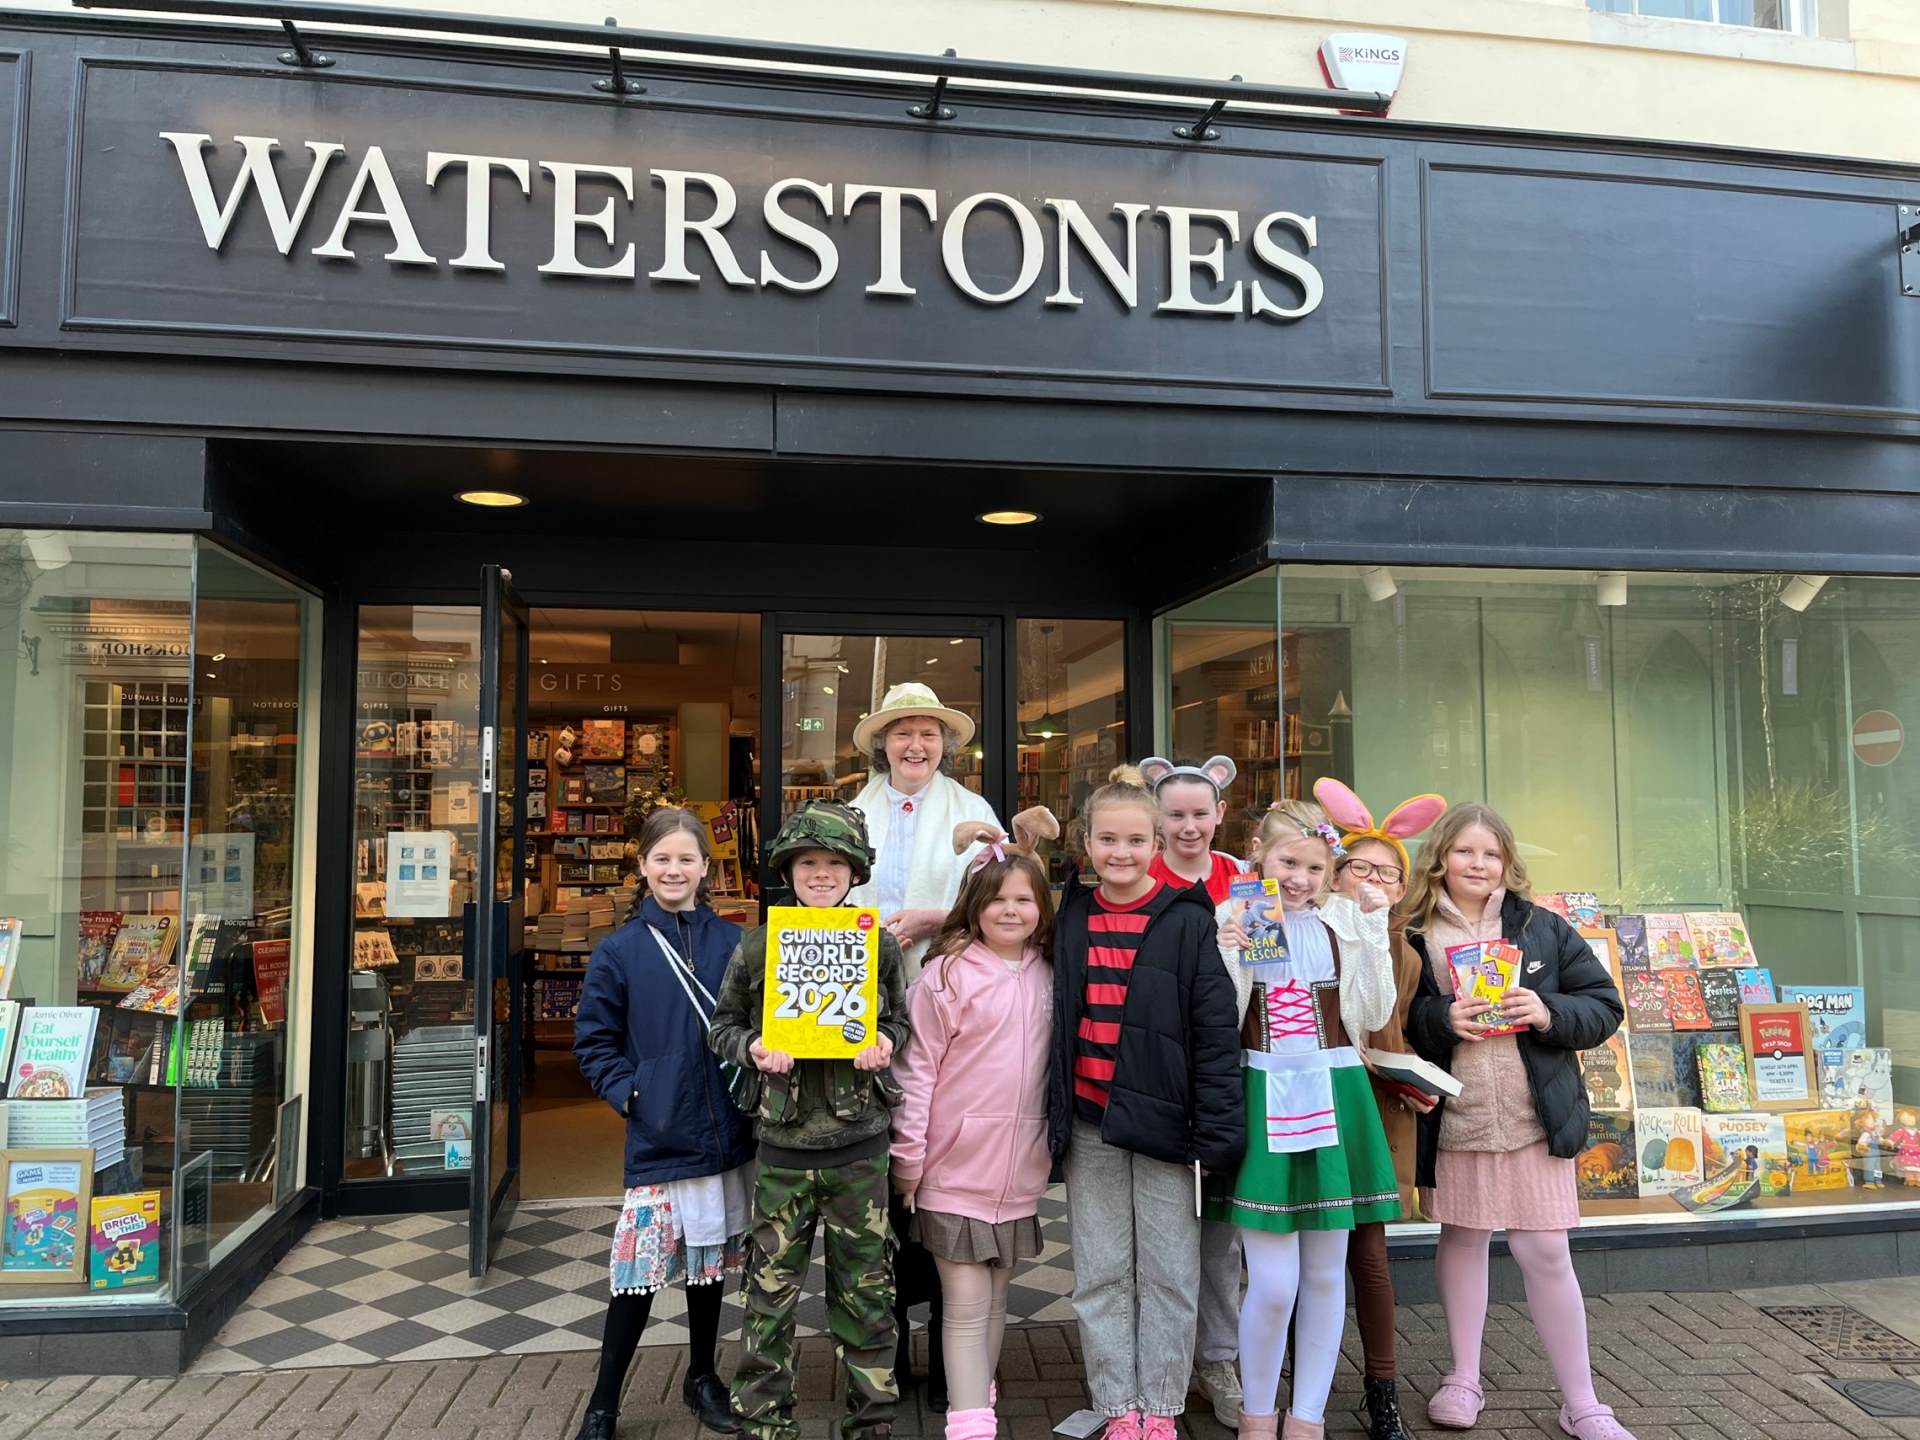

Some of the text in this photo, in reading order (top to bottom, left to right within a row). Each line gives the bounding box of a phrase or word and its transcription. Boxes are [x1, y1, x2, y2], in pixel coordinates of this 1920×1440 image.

[159, 131, 1325, 322] WATERSTONES
[1250, 654, 1274, 676] NEW
[540, 673, 622, 691] GIFTS
[117, 692, 160, 702] OURNALS
[169, 695, 202, 705] DIARES
[252, 701, 301, 709] NOTEBOO
[778, 928, 867, 945] GUINNESS
[1248, 934, 1277, 950] BEAR
[778, 944, 869, 966] WORLD
[1244, 945, 1286, 961] RESCUE
[776, 963, 869, 983] RECORDS
[774, 981, 867, 1027] 2026
[1795, 993, 1853, 1009] DOG MAN
[59, 1011, 83, 1019] Oliver
[1476, 1009, 1500, 1025] RES
[32, 1022, 54, 1034] Eat
[22, 1034, 82, 1050] Yourself
[26, 1049, 80, 1064] Healthy
[1589, 1120, 1604, 1131] Big
[1639, 1113, 1663, 1135] ROCK
[1673, 1112, 1700, 1134] ROLL
[1719, 1121, 1768, 1132] PUDSEY
[104, 1215, 139, 1231] BRICK
[120, 1222, 144, 1234] THIS!
